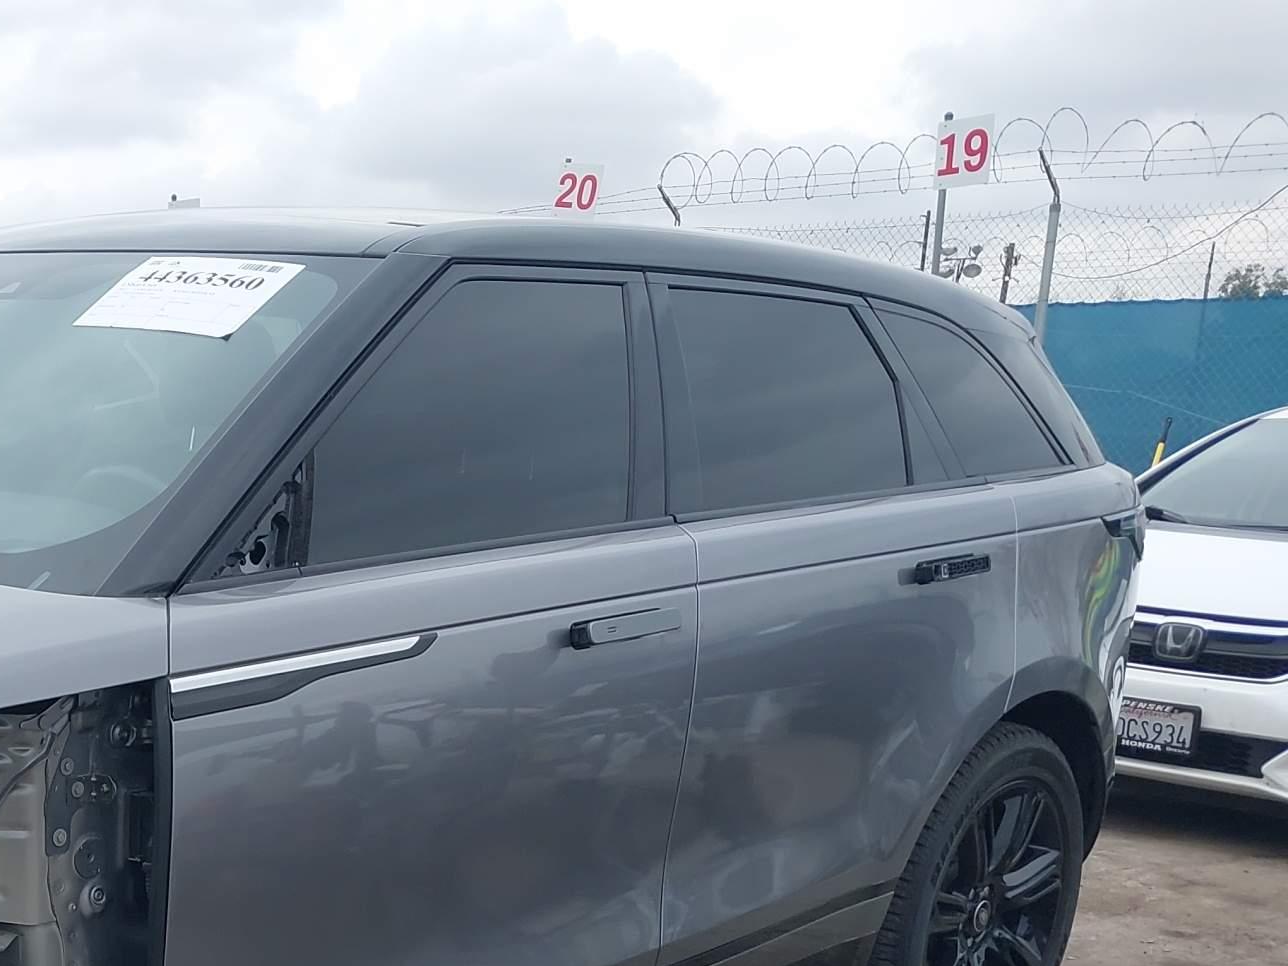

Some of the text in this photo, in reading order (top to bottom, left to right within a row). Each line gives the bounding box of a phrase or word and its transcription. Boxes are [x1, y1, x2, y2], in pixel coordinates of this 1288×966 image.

[937, 129, 988, 176] 19
[554, 173, 597, 209] 20
[139, 270, 265, 291] 44363560
[1121, 699, 1174, 713] PENSKE
[1121, 739, 1162, 752] HONDA
